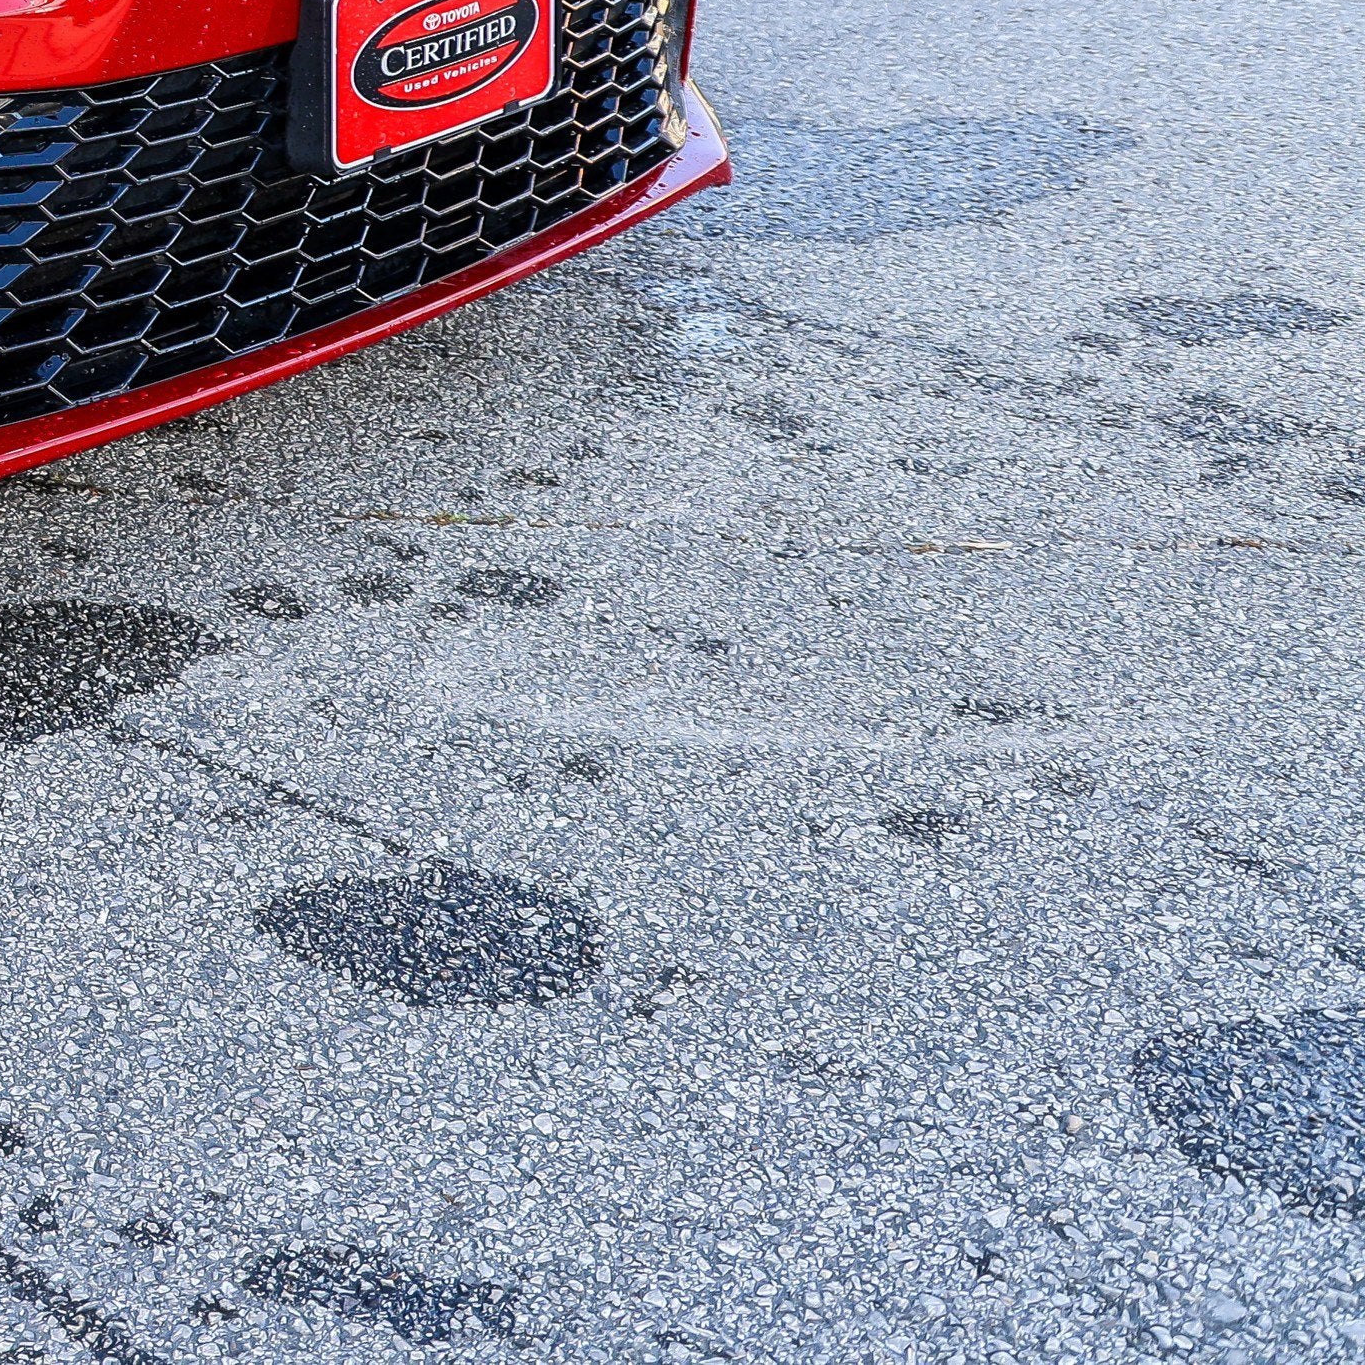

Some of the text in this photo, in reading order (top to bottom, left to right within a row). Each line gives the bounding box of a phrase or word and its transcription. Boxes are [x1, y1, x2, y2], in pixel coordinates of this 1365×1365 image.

[441, 1, 481, 25] TOYOTA
[380, 15, 517, 77] CERTIFIED
[403, 55, 498, 93] Used Vehicles
